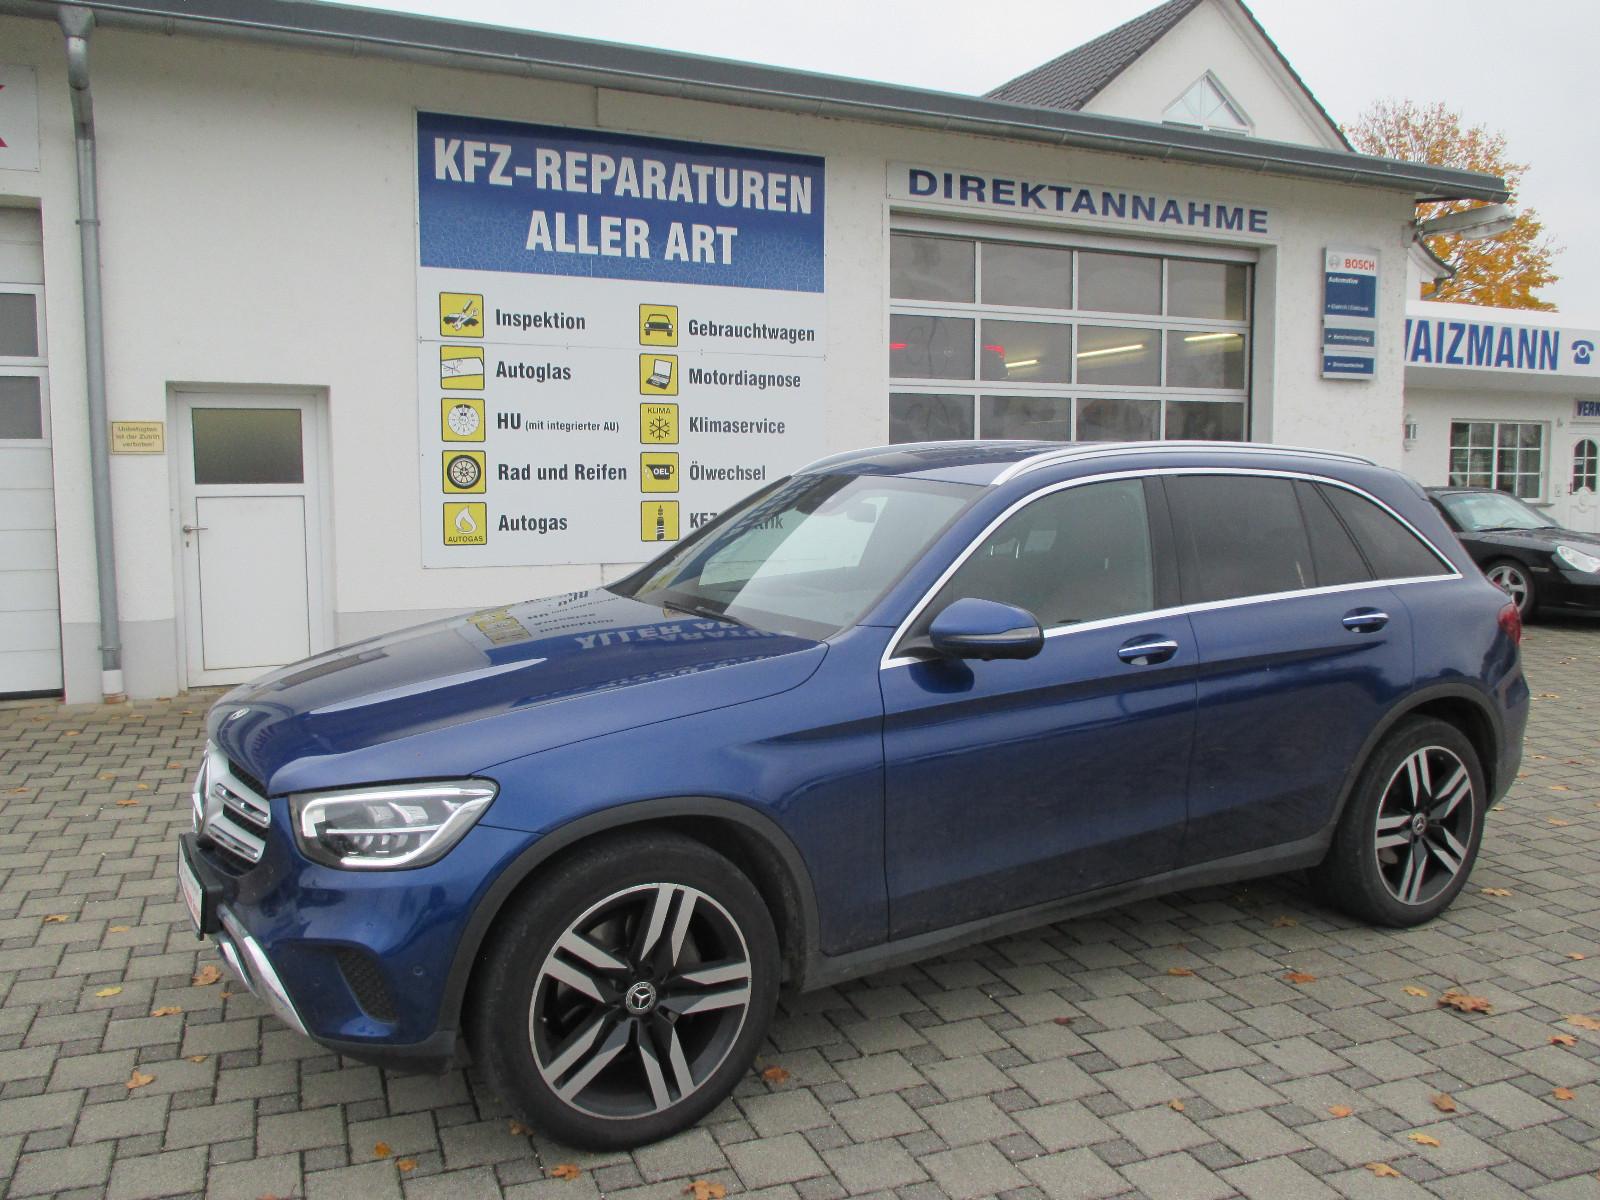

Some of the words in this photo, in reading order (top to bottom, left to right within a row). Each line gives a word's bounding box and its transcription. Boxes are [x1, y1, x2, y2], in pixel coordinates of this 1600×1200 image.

[434, 137, 812, 215] KFZ-REPARATUREN
[908, 168, 1269, 234] DIREKTANNAHME
[525, 210, 650, 259] ALLER
[664, 222, 738, 265] ART
[1343, 258, 1375, 271] BOSCH
[495, 308, 587, 331] Inspektion
[688, 319, 816, 343] Gebrauchtwagen
[495, 361, 572, 384] Autoglas
[688, 368, 801, 390] Motordiagnose
[647, 406, 672, 415] KLIMA
[497, 412, 522, 430] HU
[525, 420, 544, 432] (mit
[546, 420, 601, 433] integrierter
[603, 421, 620, 433] AU)
[689, 416, 786, 434] Klimaservice
[497, 464, 533, 481] Rad
[537, 465, 570, 481] und
[574, 464, 628, 481] Reifen
[653, 468, 670, 476] OEL
[688, 461, 767, 481] Ölwechsel
[498, 514, 569, 533] Autogas
[447, 535, 484, 543] AUTOGAS
